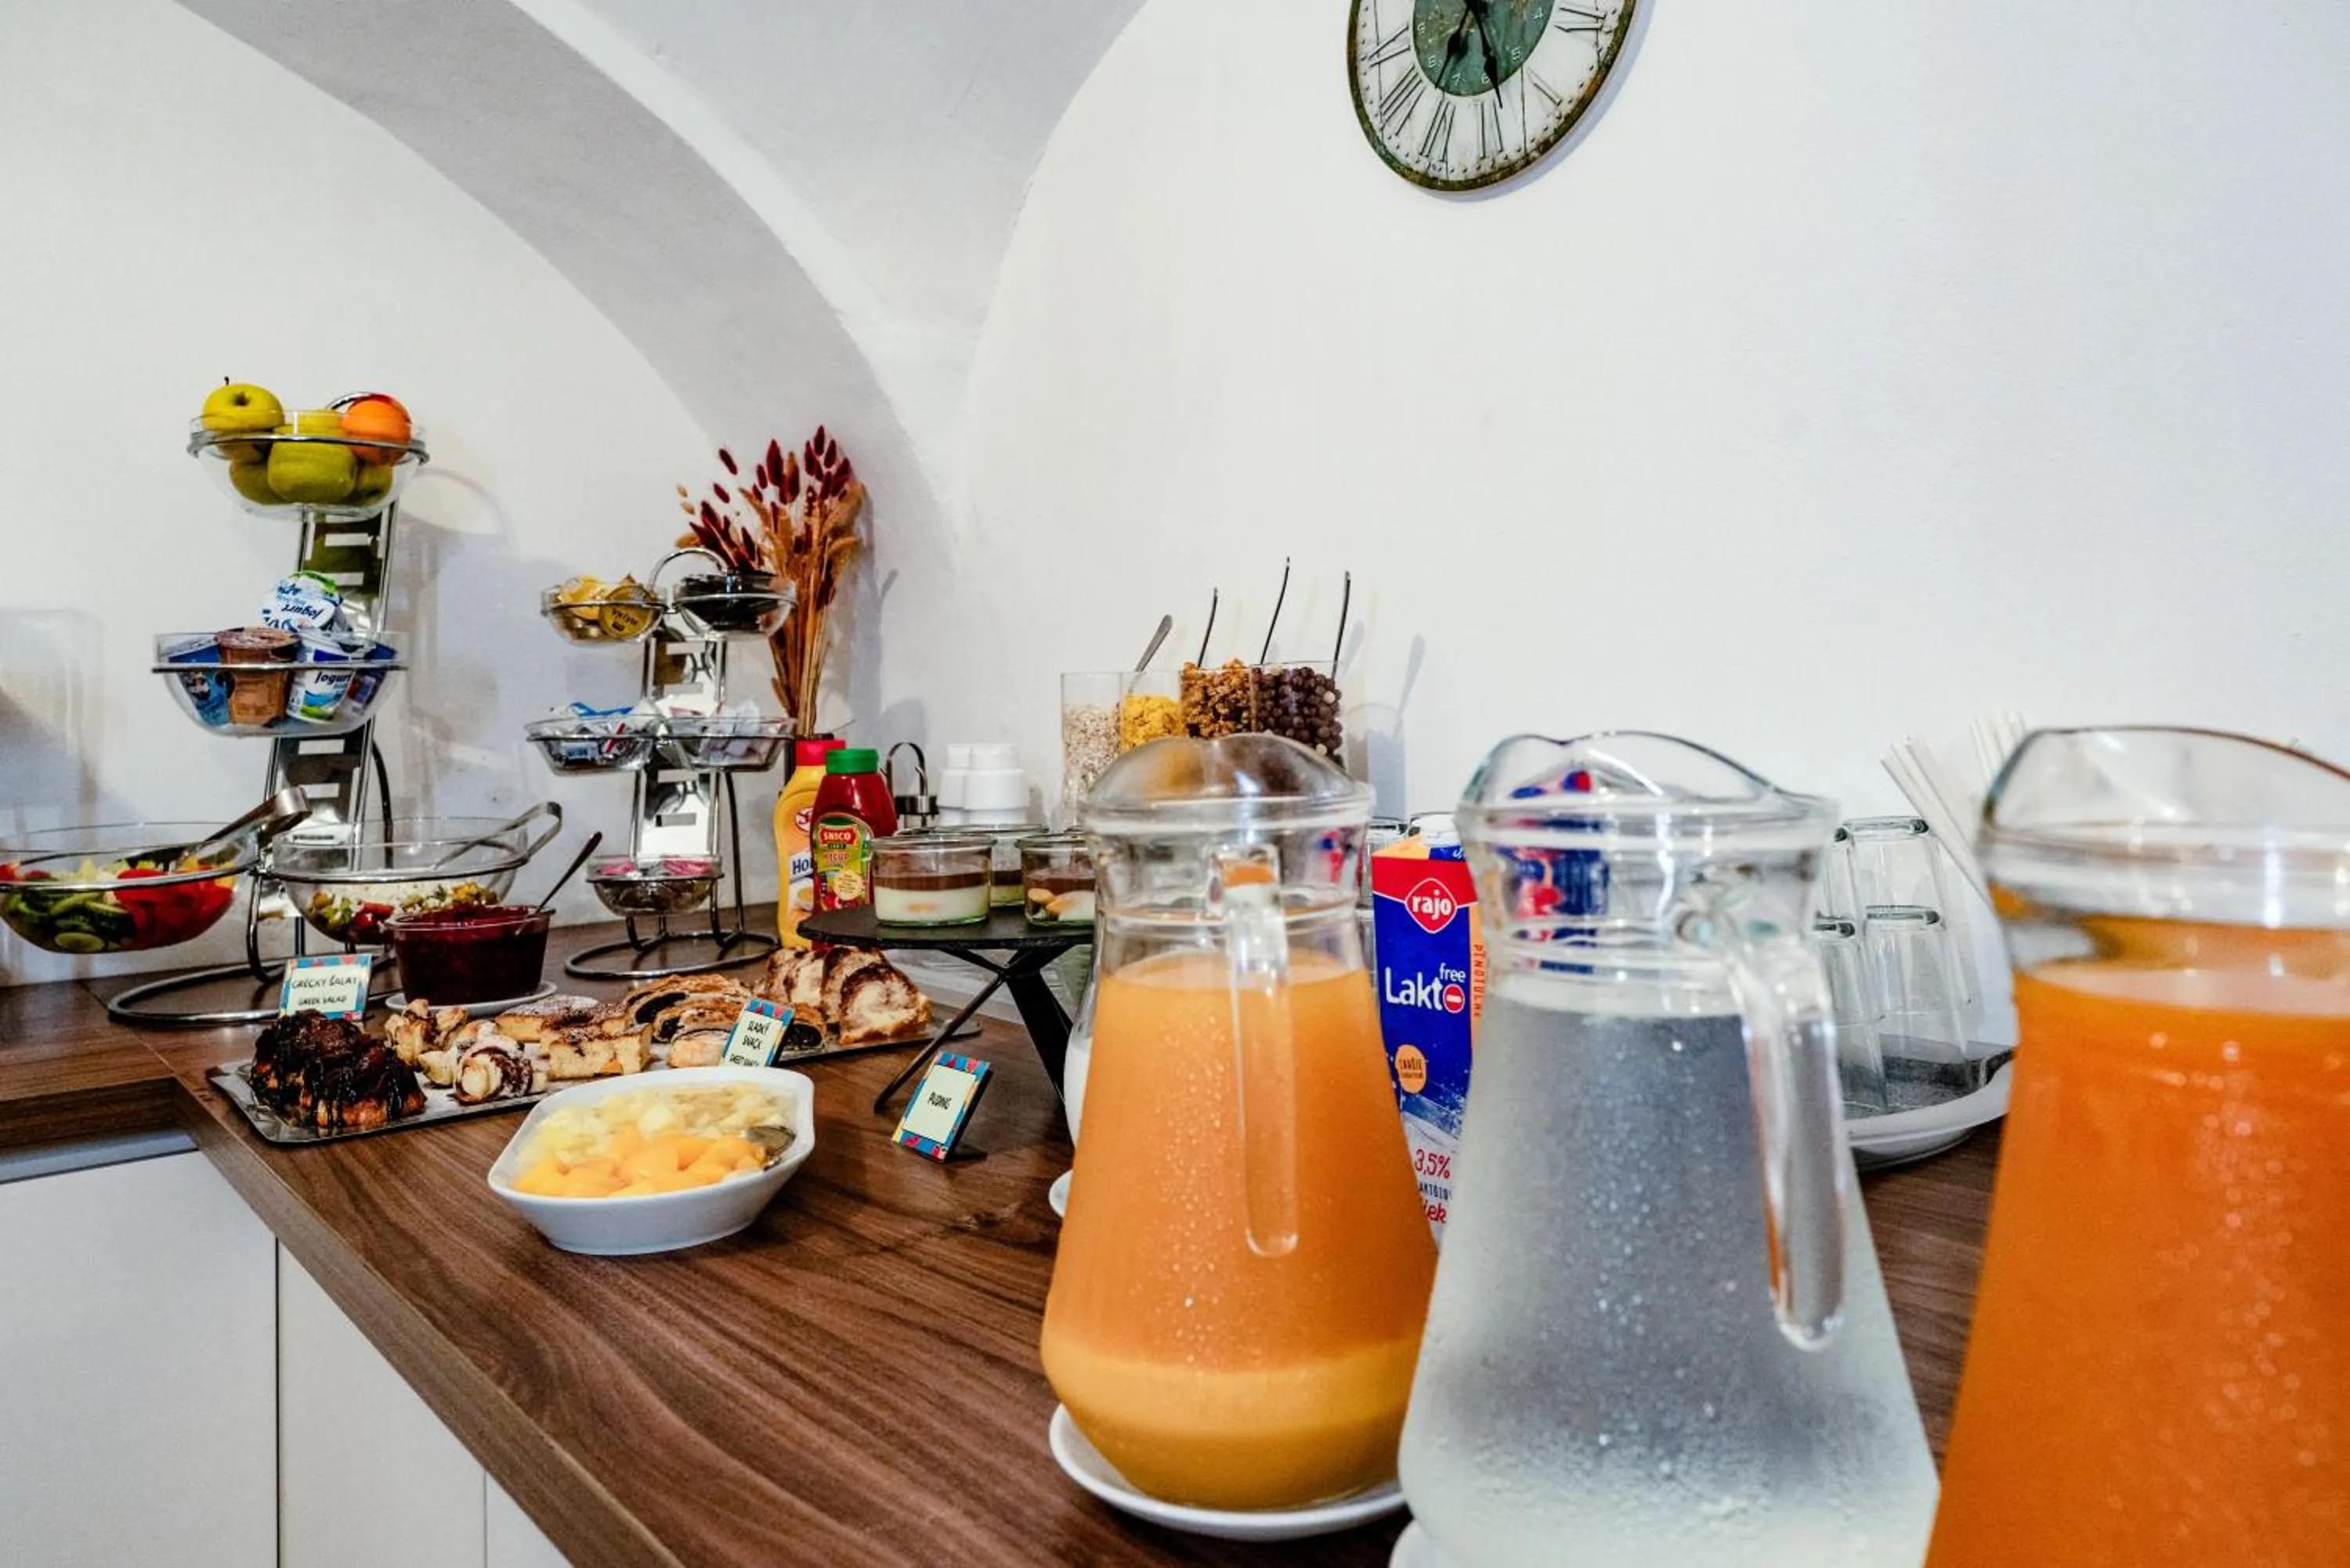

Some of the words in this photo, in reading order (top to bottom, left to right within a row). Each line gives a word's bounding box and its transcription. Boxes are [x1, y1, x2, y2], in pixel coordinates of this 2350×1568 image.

[1452, 73, 1462, 85] 7
[792, 858, 812, 875] HO
[1412, 890, 1452, 920] rajo
[1439, 963, 1466, 982] free
[1415, 1149, 1451, 1179] 3,5%
